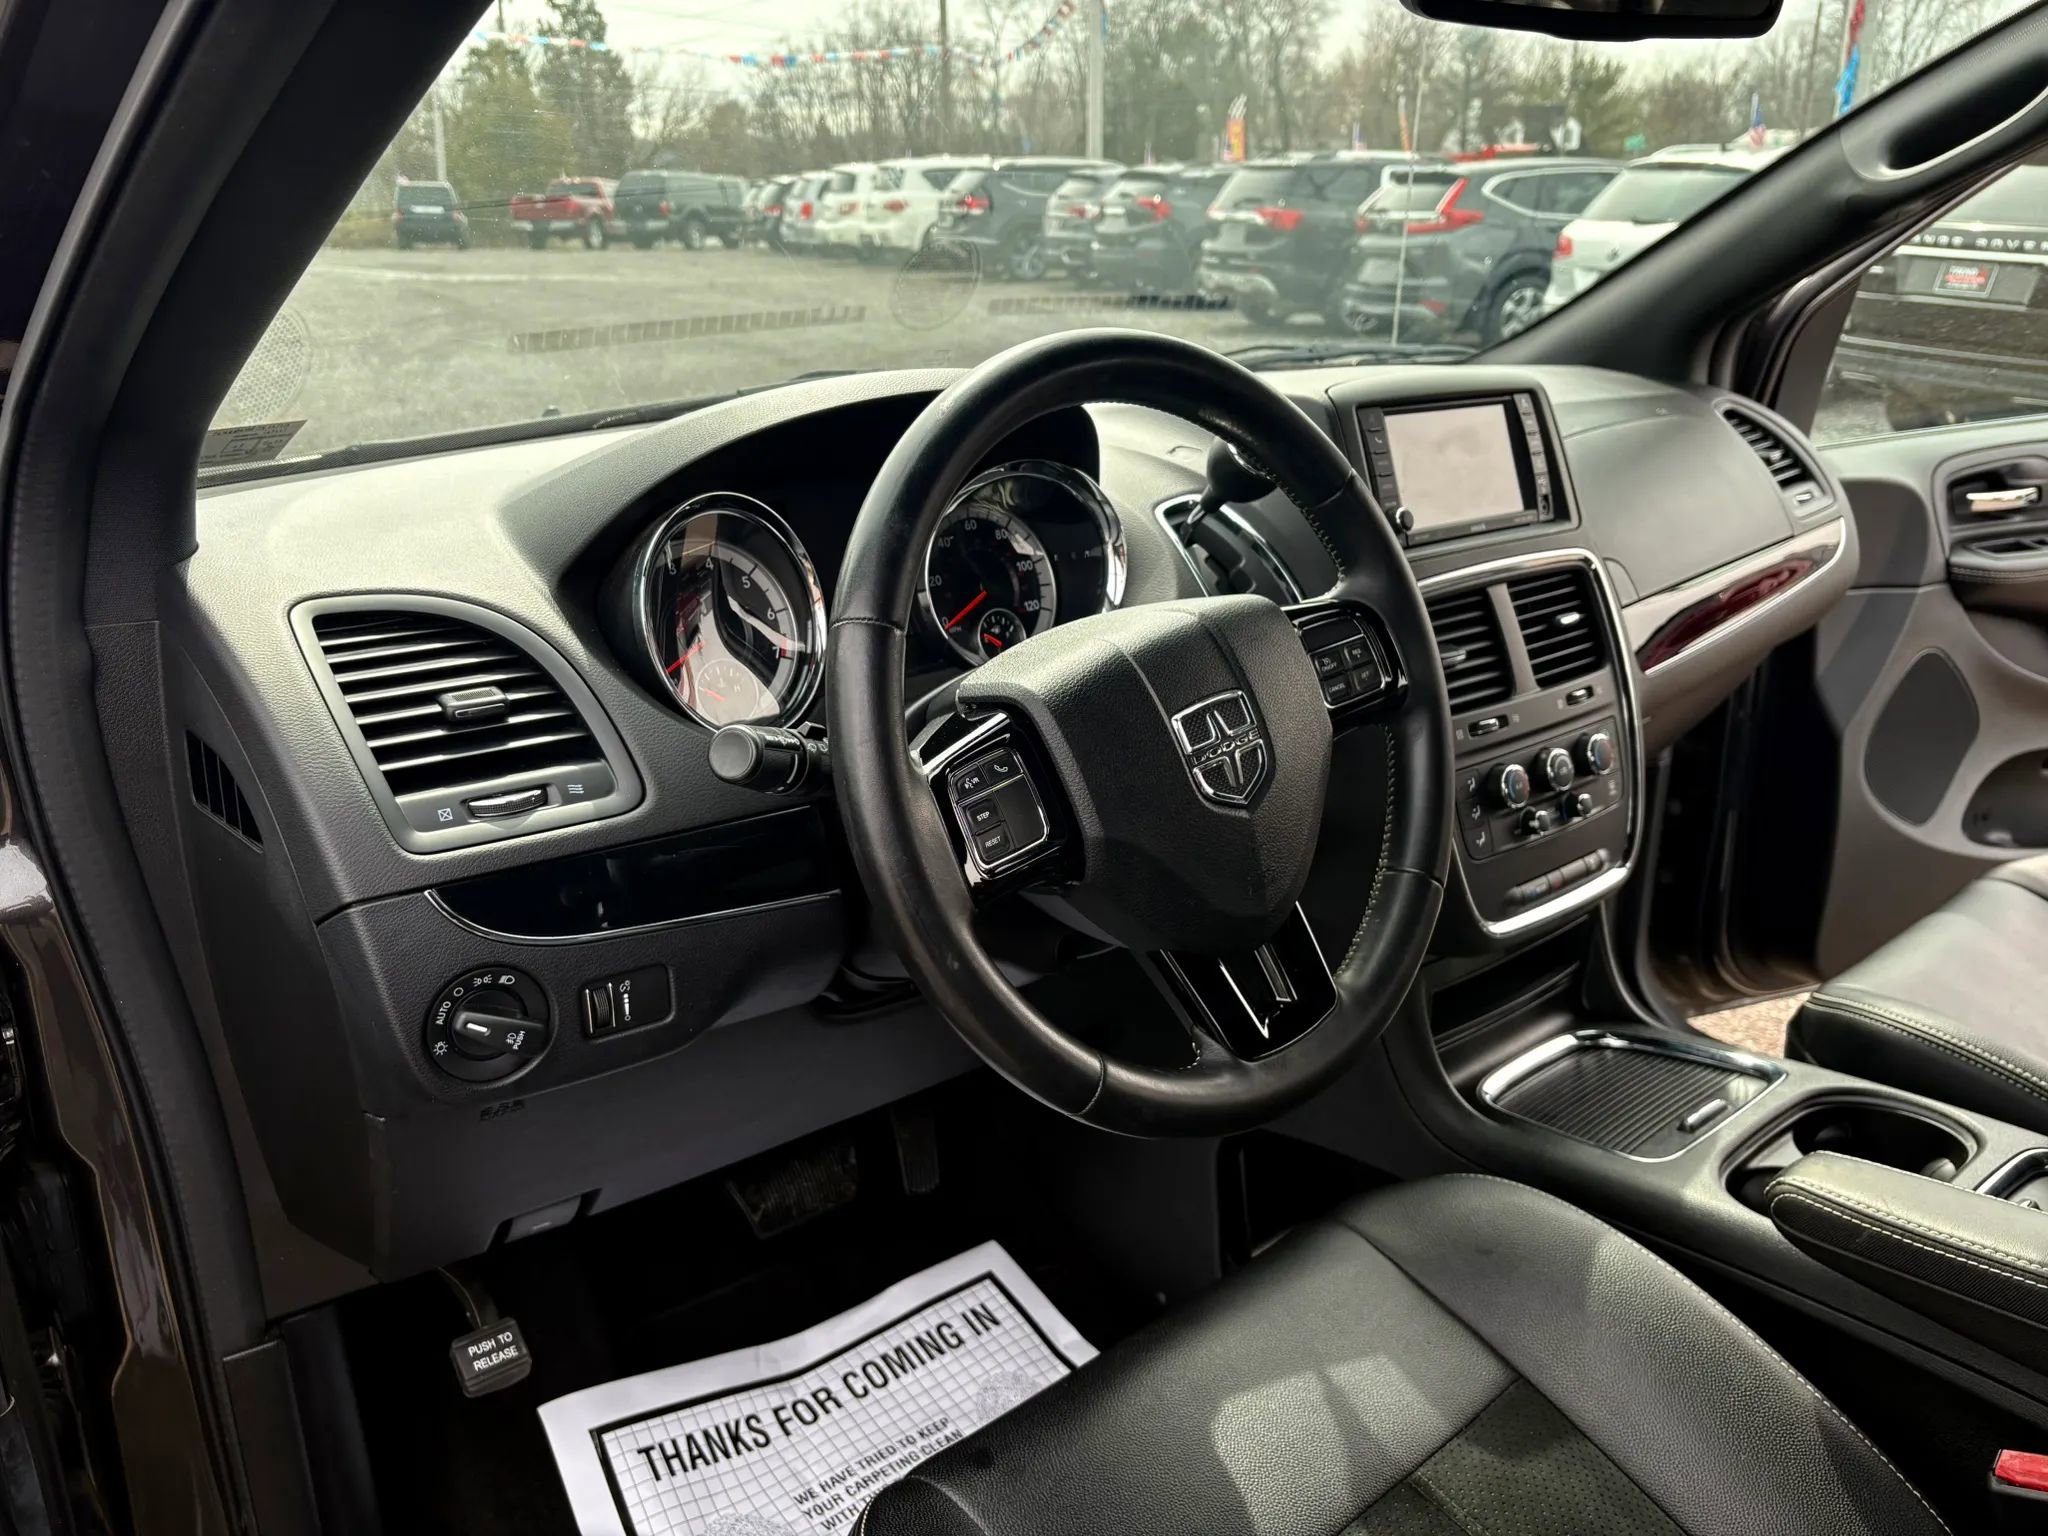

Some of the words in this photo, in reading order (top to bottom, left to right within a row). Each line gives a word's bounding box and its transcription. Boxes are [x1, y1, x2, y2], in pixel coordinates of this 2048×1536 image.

[964, 519, 977, 531] 60
[995, 528, 1009, 540] 80
[705, 557, 714, 570] 4
[1016, 560, 1034, 572] 100
[741, 575, 751, 589] 5
[929, 575, 942, 587] 20
[1024, 599, 1040, 612] 120
[767, 608, 776, 620] 6
[1328, 683, 1345, 693] CANCEL
[977, 811, 989, 821] STEP
[985, 836, 1001, 849] RESET
[435, 1001, 451, 1026] AUTO
[513, 1030, 526, 1050] PUSH
[468, 1338, 496, 1357] PUSH
[497, 1331, 513, 1344] TO
[473, 1345, 518, 1371] RELEASE
[637, 1414, 771, 1482] THANKS
[773, 1386, 844, 1437] FOR
[842, 1322, 965, 1399] COMING
[967, 1303, 1001, 1337] IN
[794, 1488, 819, 1505] WE
[820, 1465, 857, 1493] HAVE
[857, 1444, 897, 1471] TRIED
[897, 1434, 918, 1449] TO
[918, 1417, 950, 1439] KEEP
[802, 1494, 844, 1520] YOUR
[845, 1451, 920, 1497] CARPETING
[921, 1429, 963, 1457] CLEAN
[820, 1504, 861, 1531] WITH
